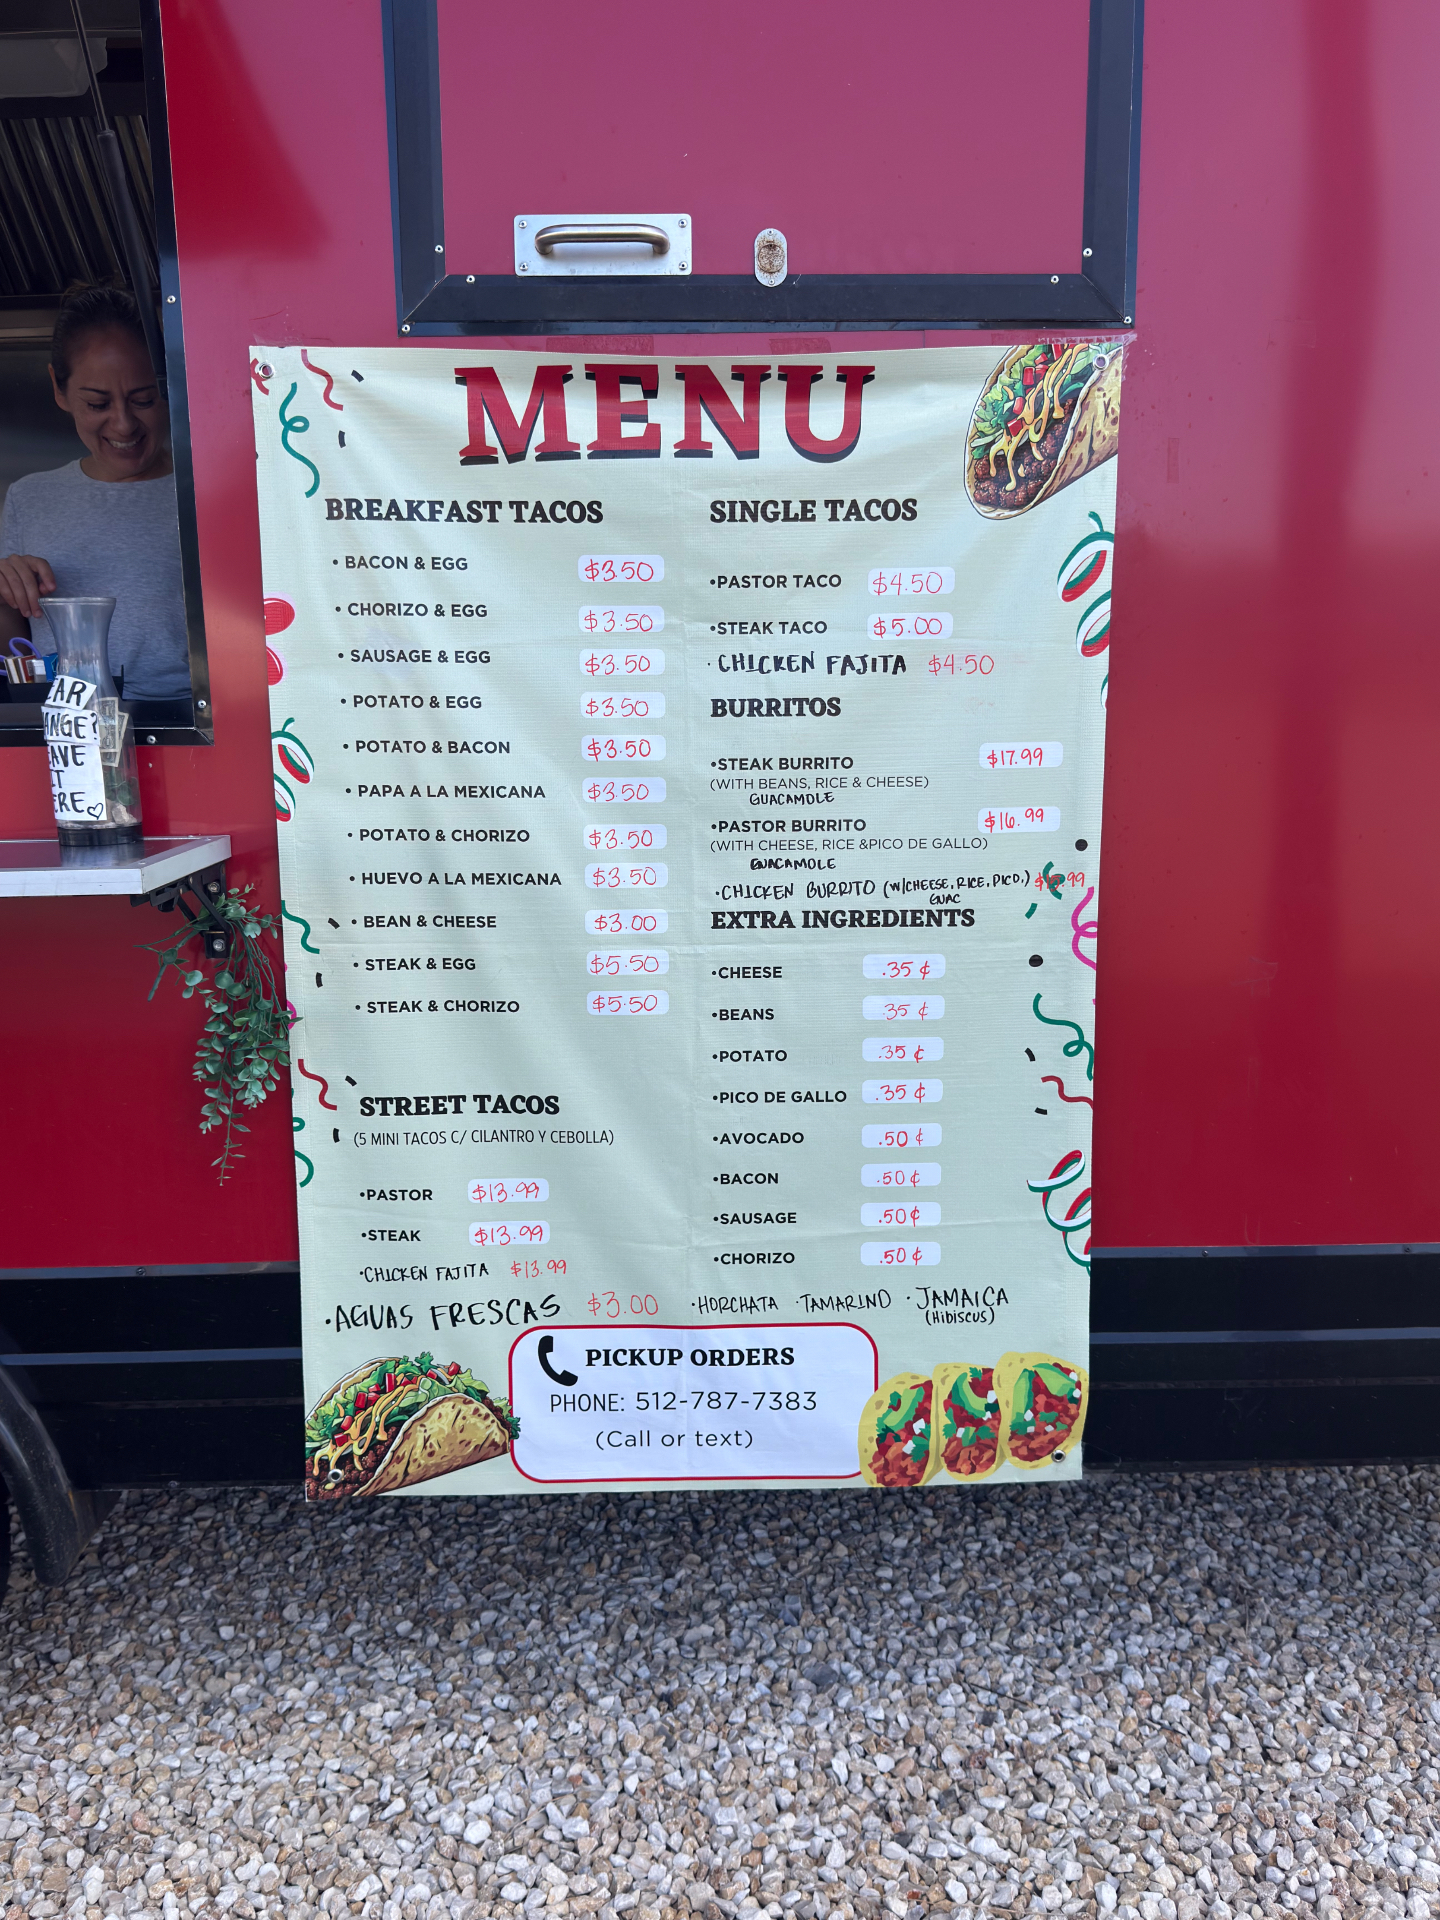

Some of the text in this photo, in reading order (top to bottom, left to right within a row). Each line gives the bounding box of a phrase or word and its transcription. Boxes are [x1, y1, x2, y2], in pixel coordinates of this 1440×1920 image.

[454, 364, 875, 466] MENU
[325, 498, 603, 523] BREAKFAST TACOS
[710, 498, 917, 523] SINGLE TACOS
[345, 556, 467, 570] BACON & EGG
[585, 559, 653, 582] $3.50
[718, 574, 841, 588] PASTOR TACO
[873, 572, 942, 596] $4.50
[348, 603, 487, 617] CHORIZO & EGG
[584, 610, 653, 632] $3.50
[718, 621, 827, 635] STEAK TACO
[874, 617, 942, 638] $5.00
[351, 650, 490, 663] SAUSAGE & EGG
[585, 653, 650, 676] $3.50
[718, 651, 906, 676] CHICKEN FAJITA
[929, 654, 994, 676] $4.50
[47, 677, 87, 708] AR
[354, 695, 481, 708] POTATO & EGG
[586, 698, 648, 717] $3.50
[710, 697, 841, 717] BURRITOS
[43, 711, 98, 741] ANGE?
[48, 744, 87, 768] AVE
[356, 740, 510, 754] POTATO & BACON
[588, 739, 651, 762] $3.50
[718, 757, 853, 770] STEAK BURRITO
[987, 748, 1043, 768] $17.99
[358, 785, 545, 798] PAPA A LA MEXICANA
[588, 782, 649, 802] $3.50
[710, 776, 928, 791] (WITH BEANS, RICE & CHEESE)
[719, 819, 866, 832] PASTOR BURRITO
[984, 808, 1044, 833] $16.99
[360, 829, 530, 842] POTATO & CHORIZO
[589, 829, 652, 849] $3.50
[711, 838, 987, 852] (WITH CHEESE, RICE &PICO DE GALLO)
[362, 872, 561, 885] HUEVO A LA MEXICANA
[593, 867, 656, 888] $3.50
[722, 883, 793, 900] CHICKEN
[807, 880, 875, 898] BURRITO
[364, 915, 496, 928] BEAN & CHEESE
[594, 913, 656, 932] $3.00
[711, 909, 975, 929] EXTRA INGREDIENTS
[366, 958, 475, 971] STEAK & EGG
[590, 955, 659, 975] $5.50
[719, 966, 782, 979] CHEESE
[367, 1000, 519, 1013] STEAK & CHORIZO
[593, 995, 657, 1013] $5.50
[720, 1008, 774, 1020] BEANS
[720, 1050, 787, 1062] POTATO
[360, 1094, 559, 1116] STREET TACOS
[720, 1091, 847, 1103] PICO DE GALLO
[354, 1130, 613, 1147] (5 MINI TACOS C/ CILANTRO Y CEBOLLA)
[720, 1132, 804, 1144] AVOCADO
[721, 1173, 778, 1184] BACON
[367, 1189, 432, 1201] PASTOR
[472, 1182, 539, 1203] $13.99
[720, 1212, 796, 1224] SAUSAGE
[368, 1230, 421, 1241] STEAK
[474, 1225, 543, 1246] $13.99
[721, 1252, 795, 1265] CHORIZO
[364, 1263, 489, 1282] CHICKEN FAJITA
[510, 1260, 566, 1278] $13.99
[588, 1291, 658, 1318] $3.00
[698, 1296, 778, 1314] HORCHATA
[916, 1286, 1008, 1309] JAMAICA
[336, 1294, 560, 1332] AGUAS FRESCAS
[585, 1347, 794, 1366] PICKUP ORDERS
[551, 1391, 816, 1412] PHONE: 512-787-7383
[596, 1430, 752, 1450] (Call or text)
